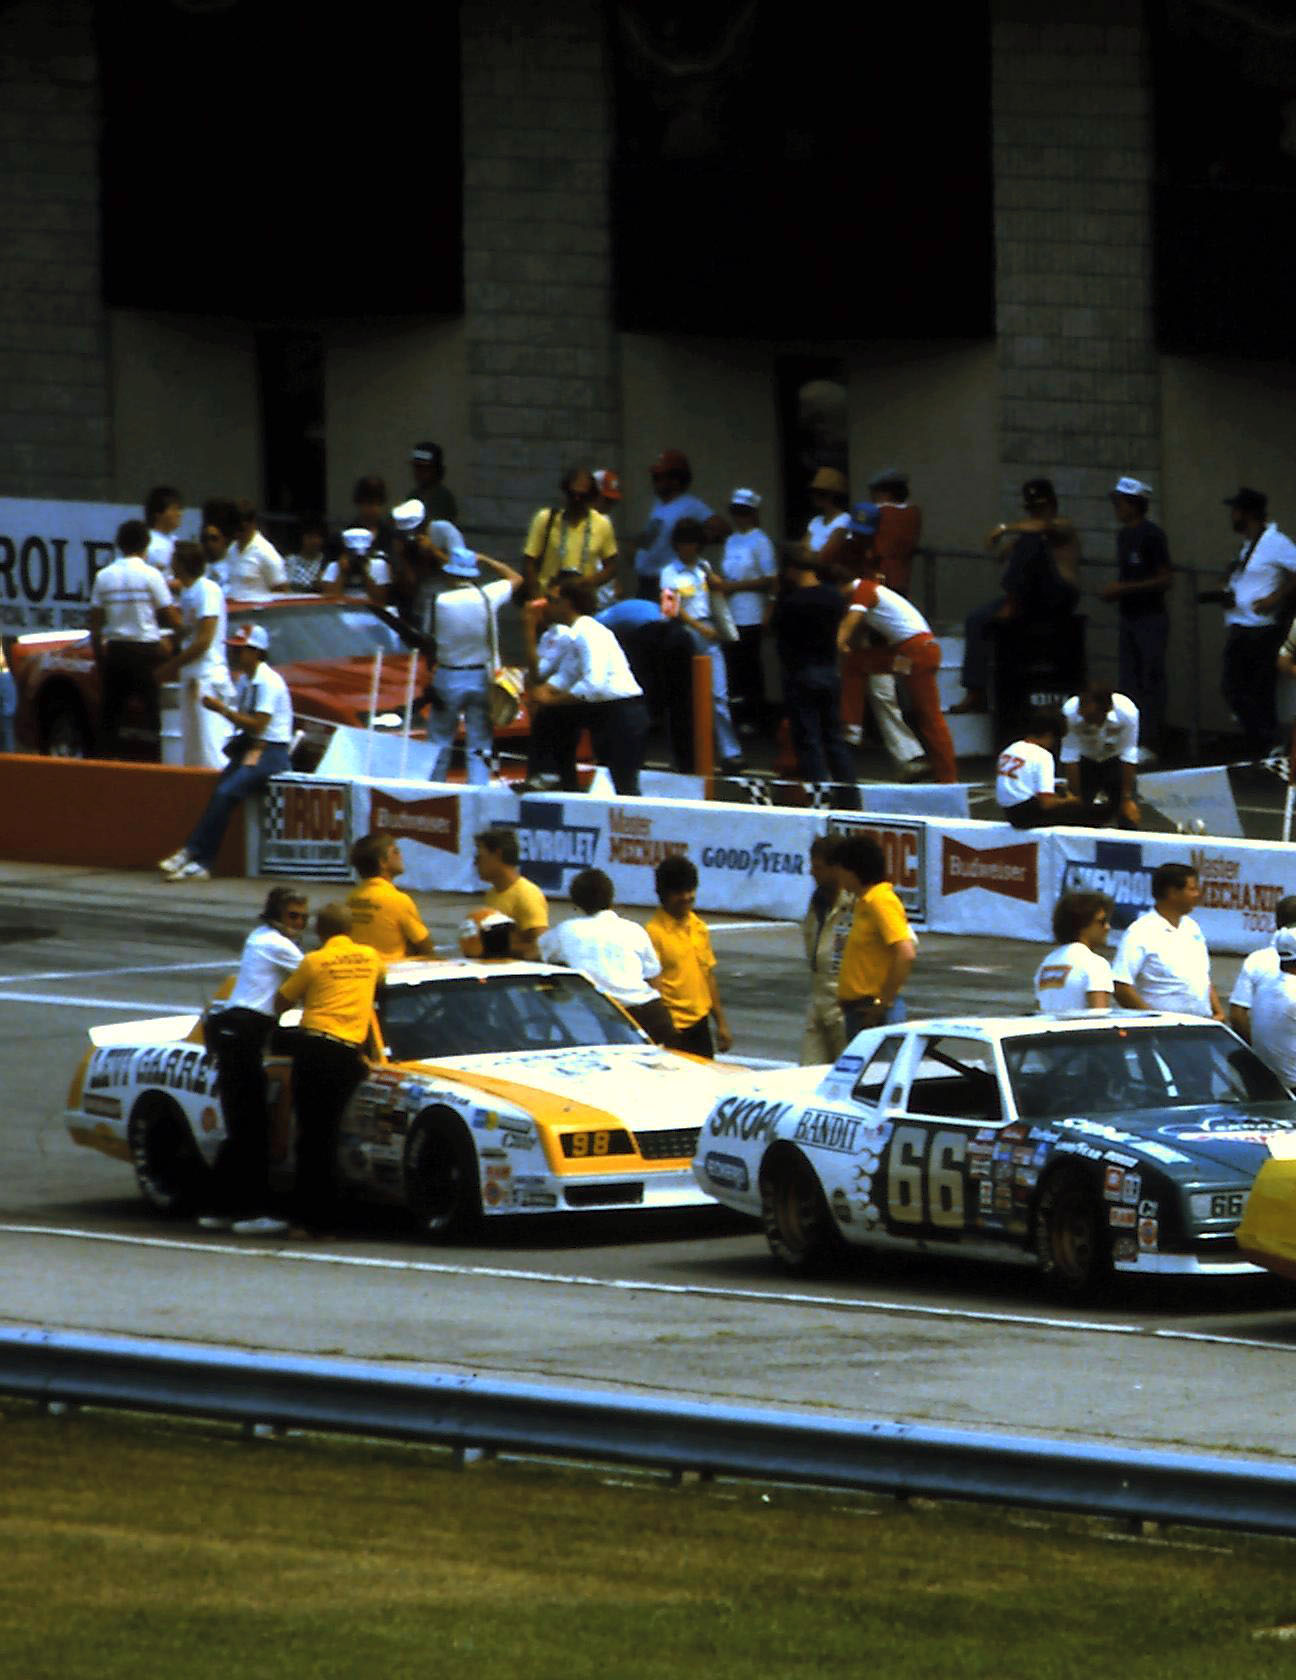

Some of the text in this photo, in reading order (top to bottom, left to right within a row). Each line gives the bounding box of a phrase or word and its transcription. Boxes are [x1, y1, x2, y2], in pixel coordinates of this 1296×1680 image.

[949, 855, 1027, 882] Budweiser
[572, 1130, 610, 1157] 98
[793, 1110, 863, 1151] BANDIT
[887, 1126, 968, 1230] 66
[1210, 1195, 1244, 1218] 66
